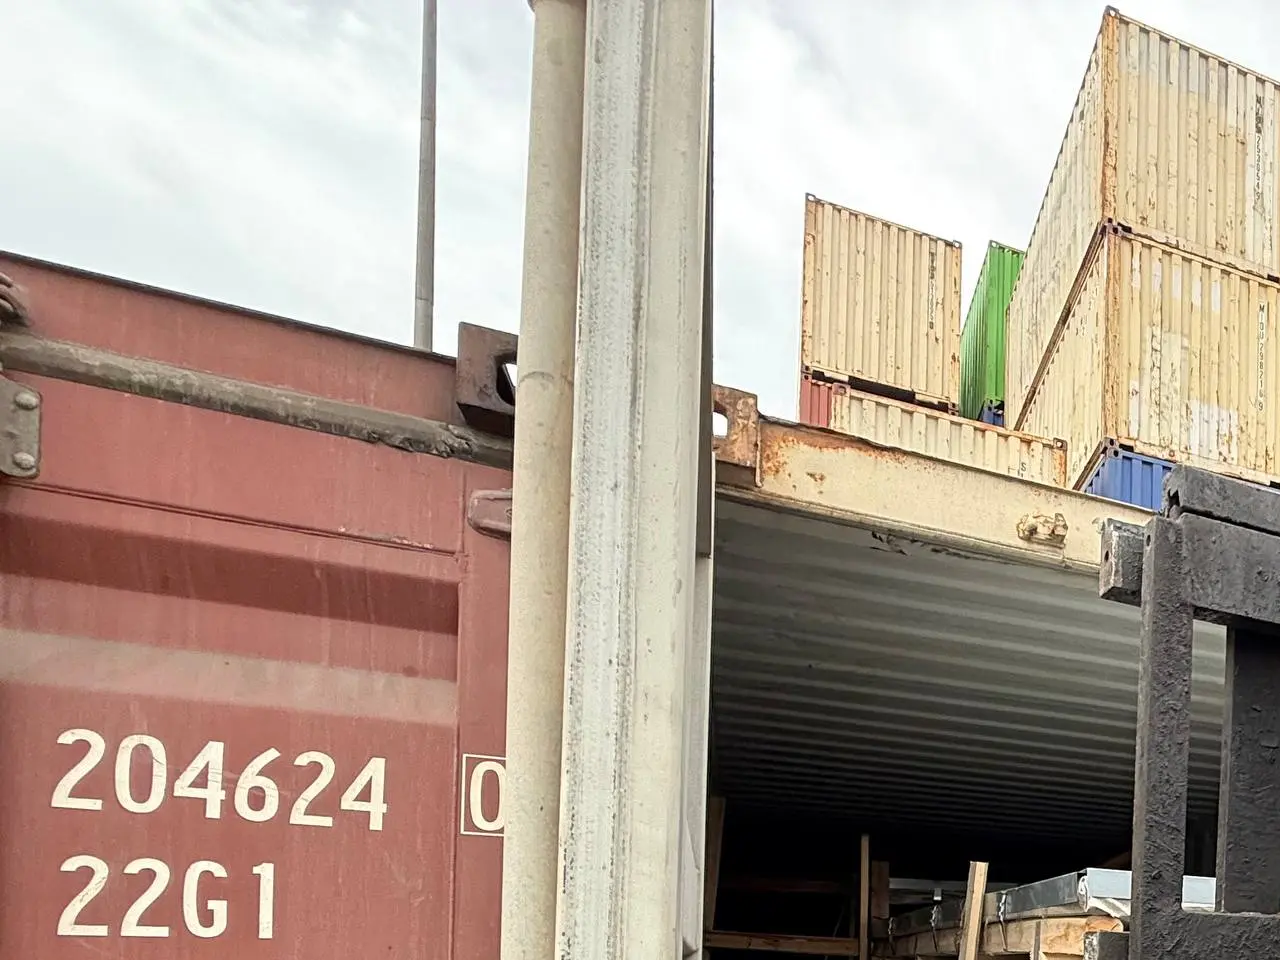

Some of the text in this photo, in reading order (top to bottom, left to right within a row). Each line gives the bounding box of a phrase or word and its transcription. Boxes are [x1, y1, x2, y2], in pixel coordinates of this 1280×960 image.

[50, 728, 506, 831] 204624 0
[57, 855, 275, 939] 22G1
